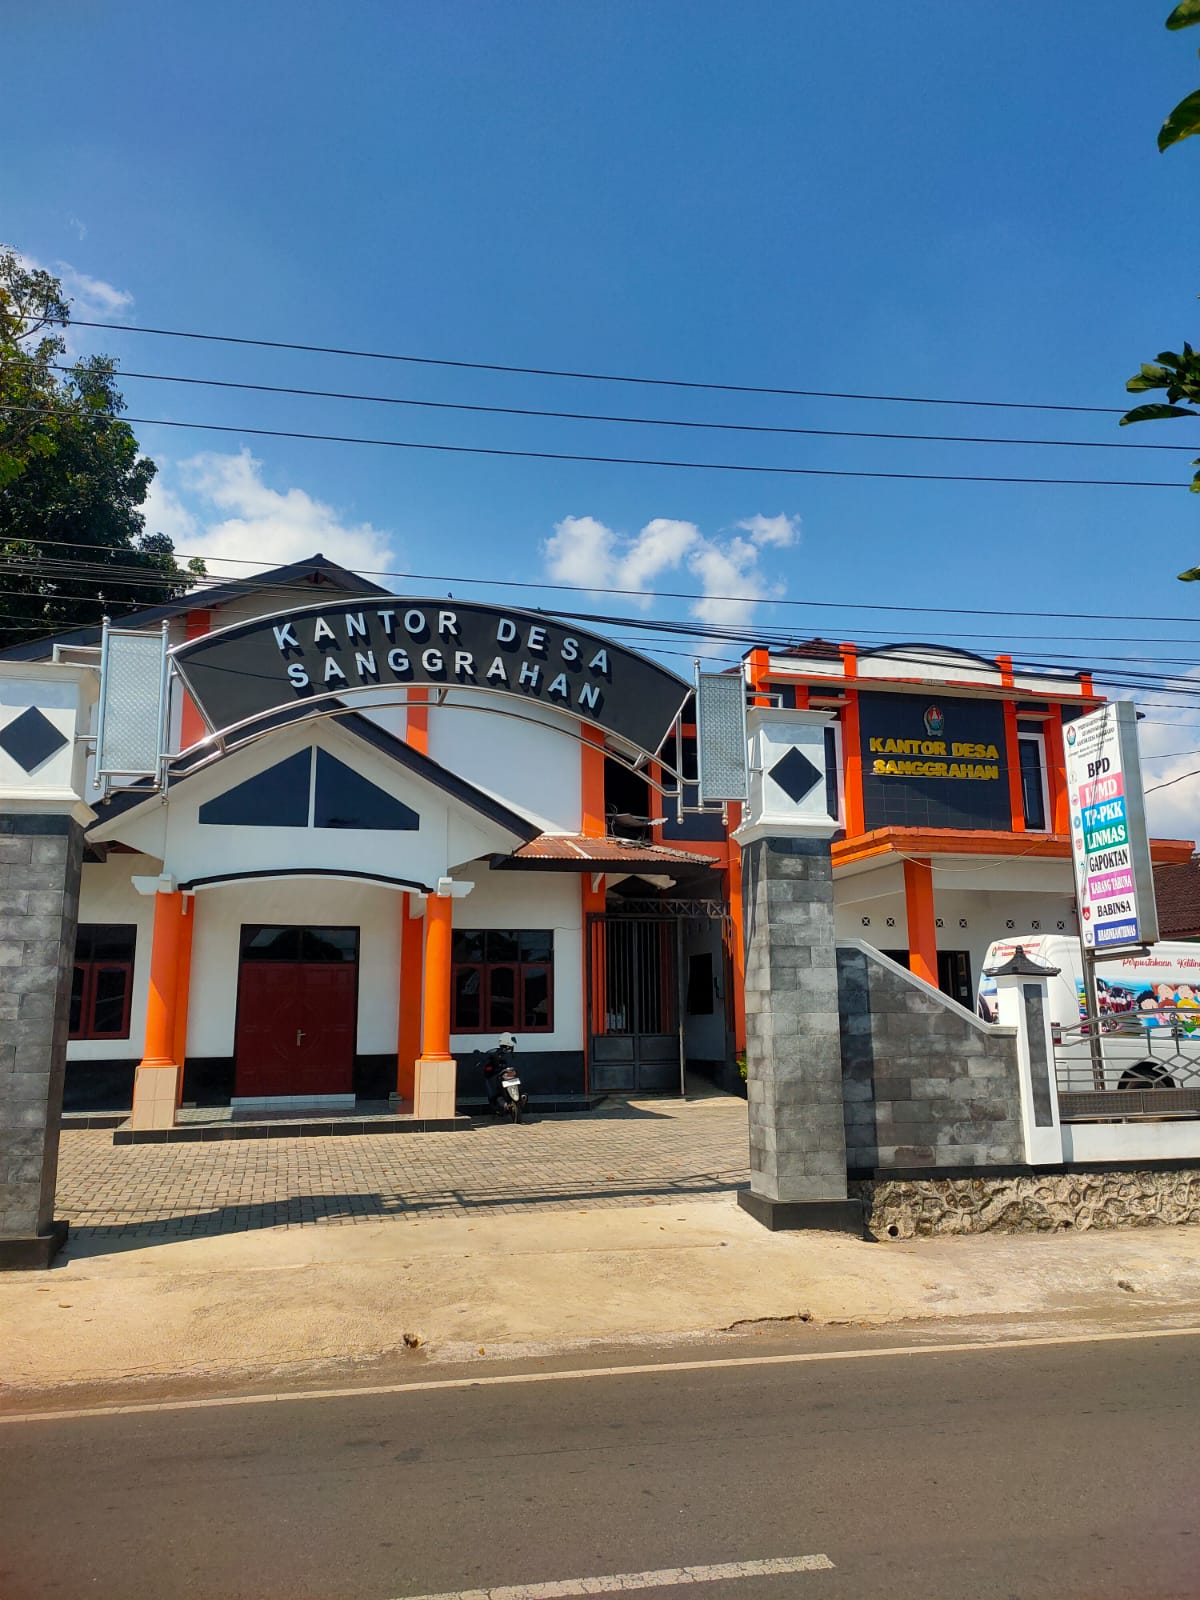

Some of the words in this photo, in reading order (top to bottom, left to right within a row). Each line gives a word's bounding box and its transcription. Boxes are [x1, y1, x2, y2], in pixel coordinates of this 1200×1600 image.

[273, 609, 459, 650] KANTOR
[496, 617, 609, 674] DESA
[287, 647, 602, 709] SANGGRAHAN
[869, 737, 947, 756] KANTOR
[951, 742, 999, 760] DESA
[872, 759, 999, 780] SANGGRAHAN
[1087, 757, 1110, 779] BPD
[1084, 800, 1124, 827] TP-PKK
[1086, 824, 1126, 851] LINMAS
[1089, 848, 1129, 873] GAPOKTAN
[1090, 879, 1111, 895] KARANG
[1097, 900, 1132, 918] BABINSA
